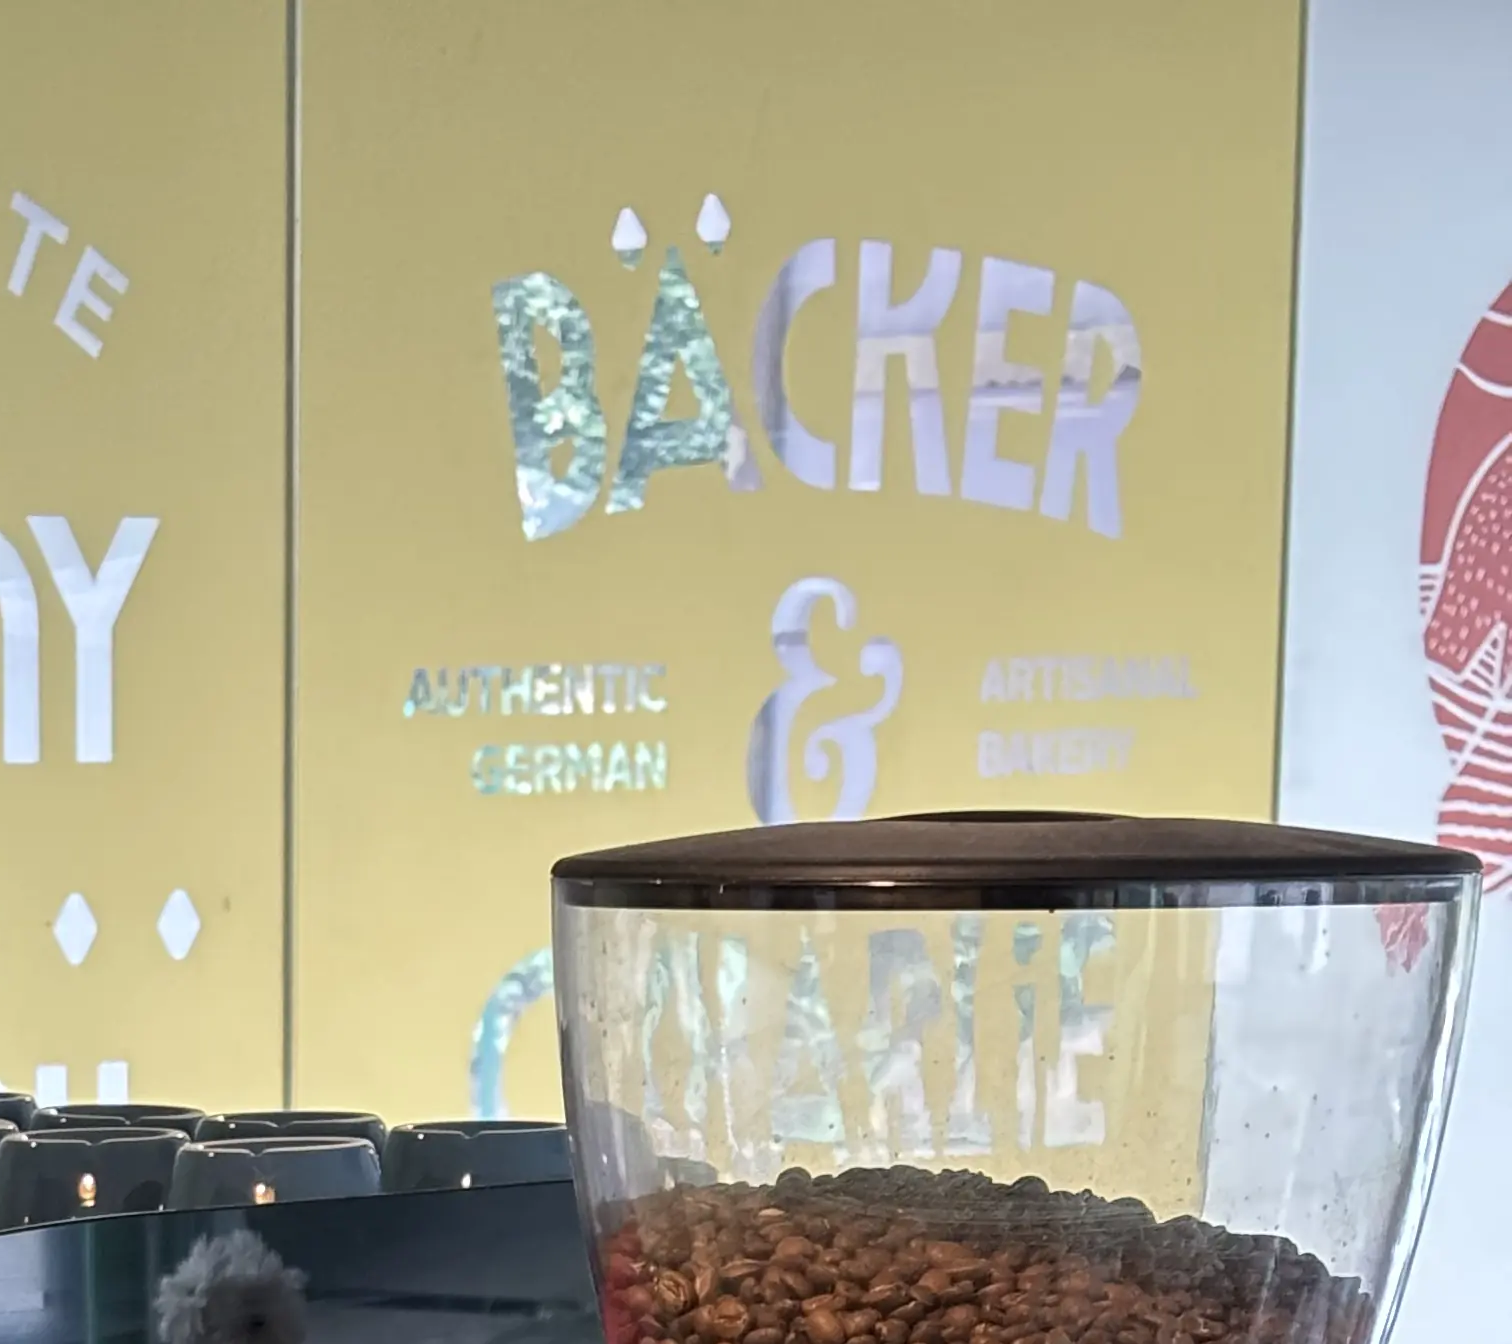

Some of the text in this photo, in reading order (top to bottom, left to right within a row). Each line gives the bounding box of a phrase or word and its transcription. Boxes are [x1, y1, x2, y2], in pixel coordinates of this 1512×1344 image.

[492, 193, 1143, 541] BÄCKER
[401, 662, 669, 718] AUTHENTIC
[469, 738, 669, 796] GERMAN
[976, 726, 1136, 780] BAKERY
